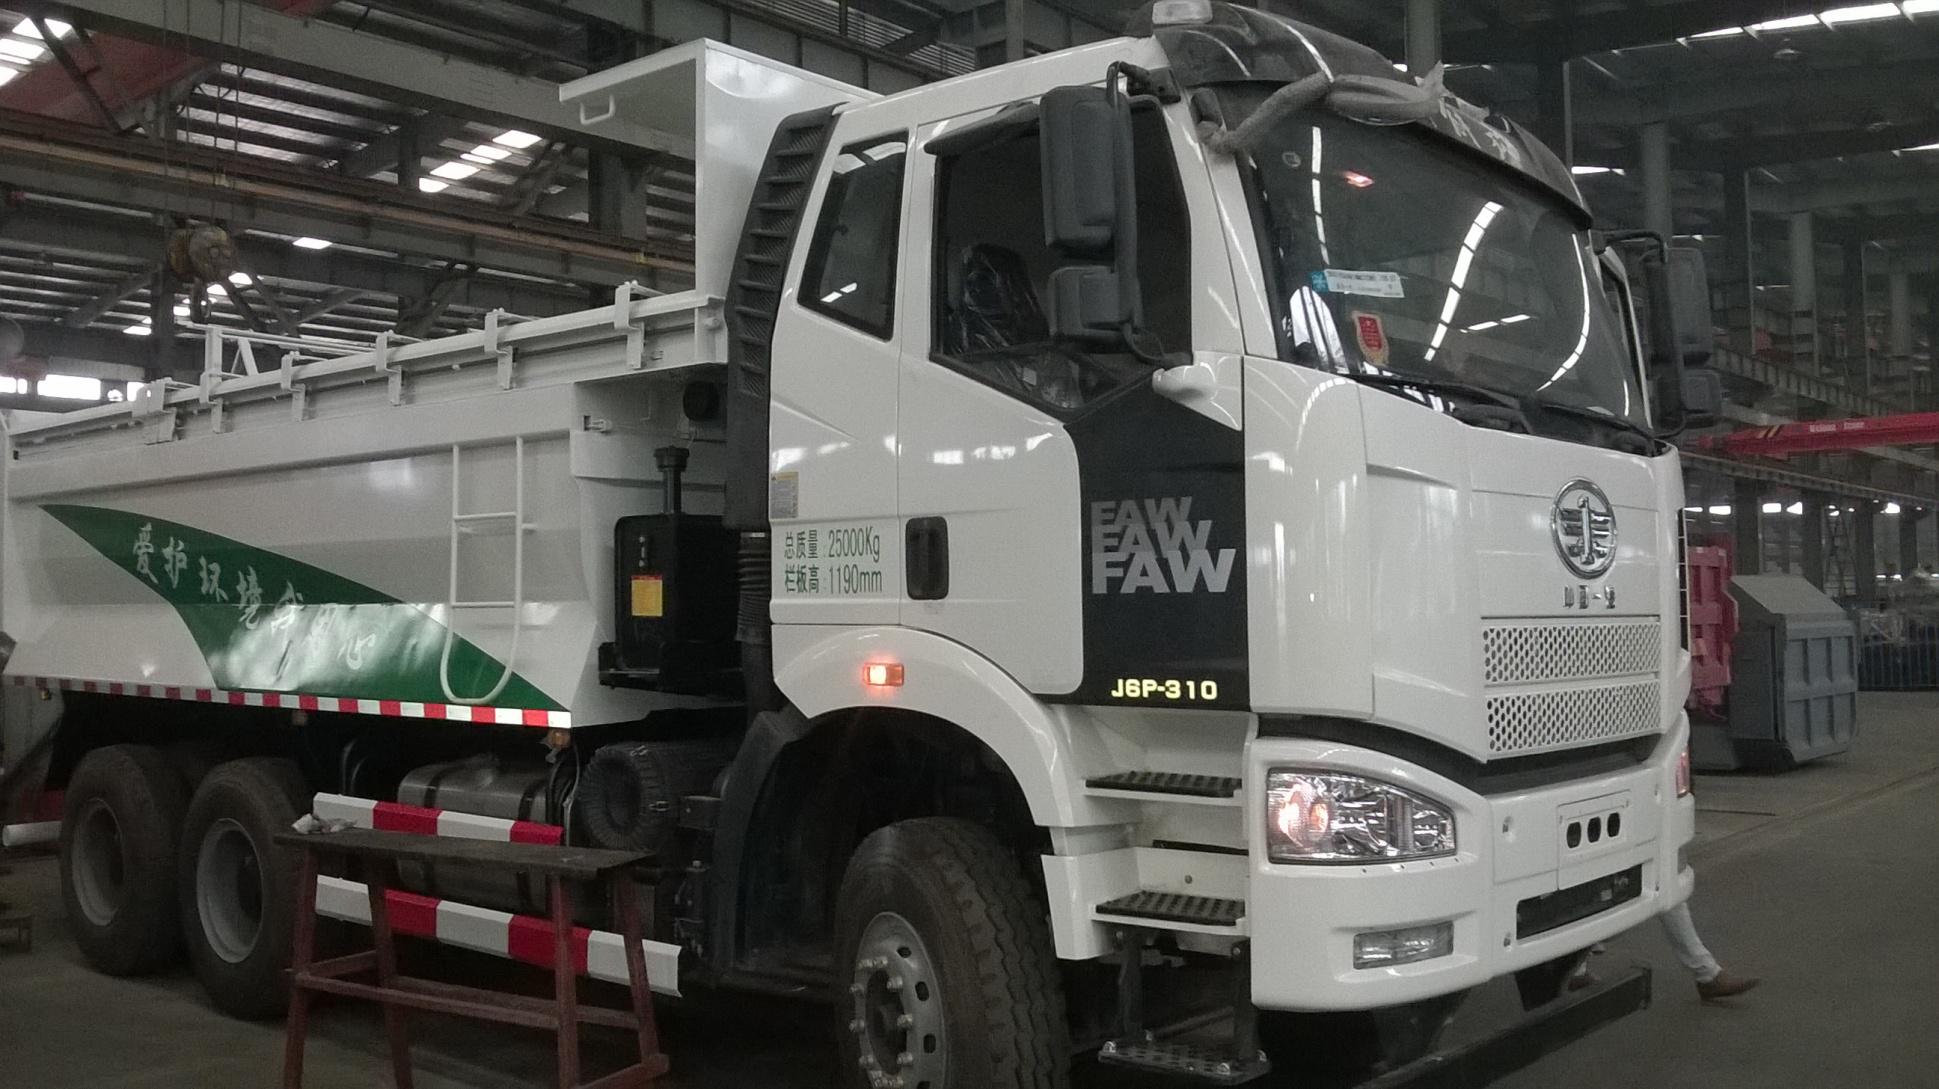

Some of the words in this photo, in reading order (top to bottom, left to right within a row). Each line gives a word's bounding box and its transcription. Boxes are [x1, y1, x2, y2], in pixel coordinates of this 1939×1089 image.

[828, 526, 881, 563] 25000Kg
[828, 564, 883, 594] 1190mm
[1092, 548, 1237, 594] FAW
[1110, 678, 1218, 700] J6P-310
